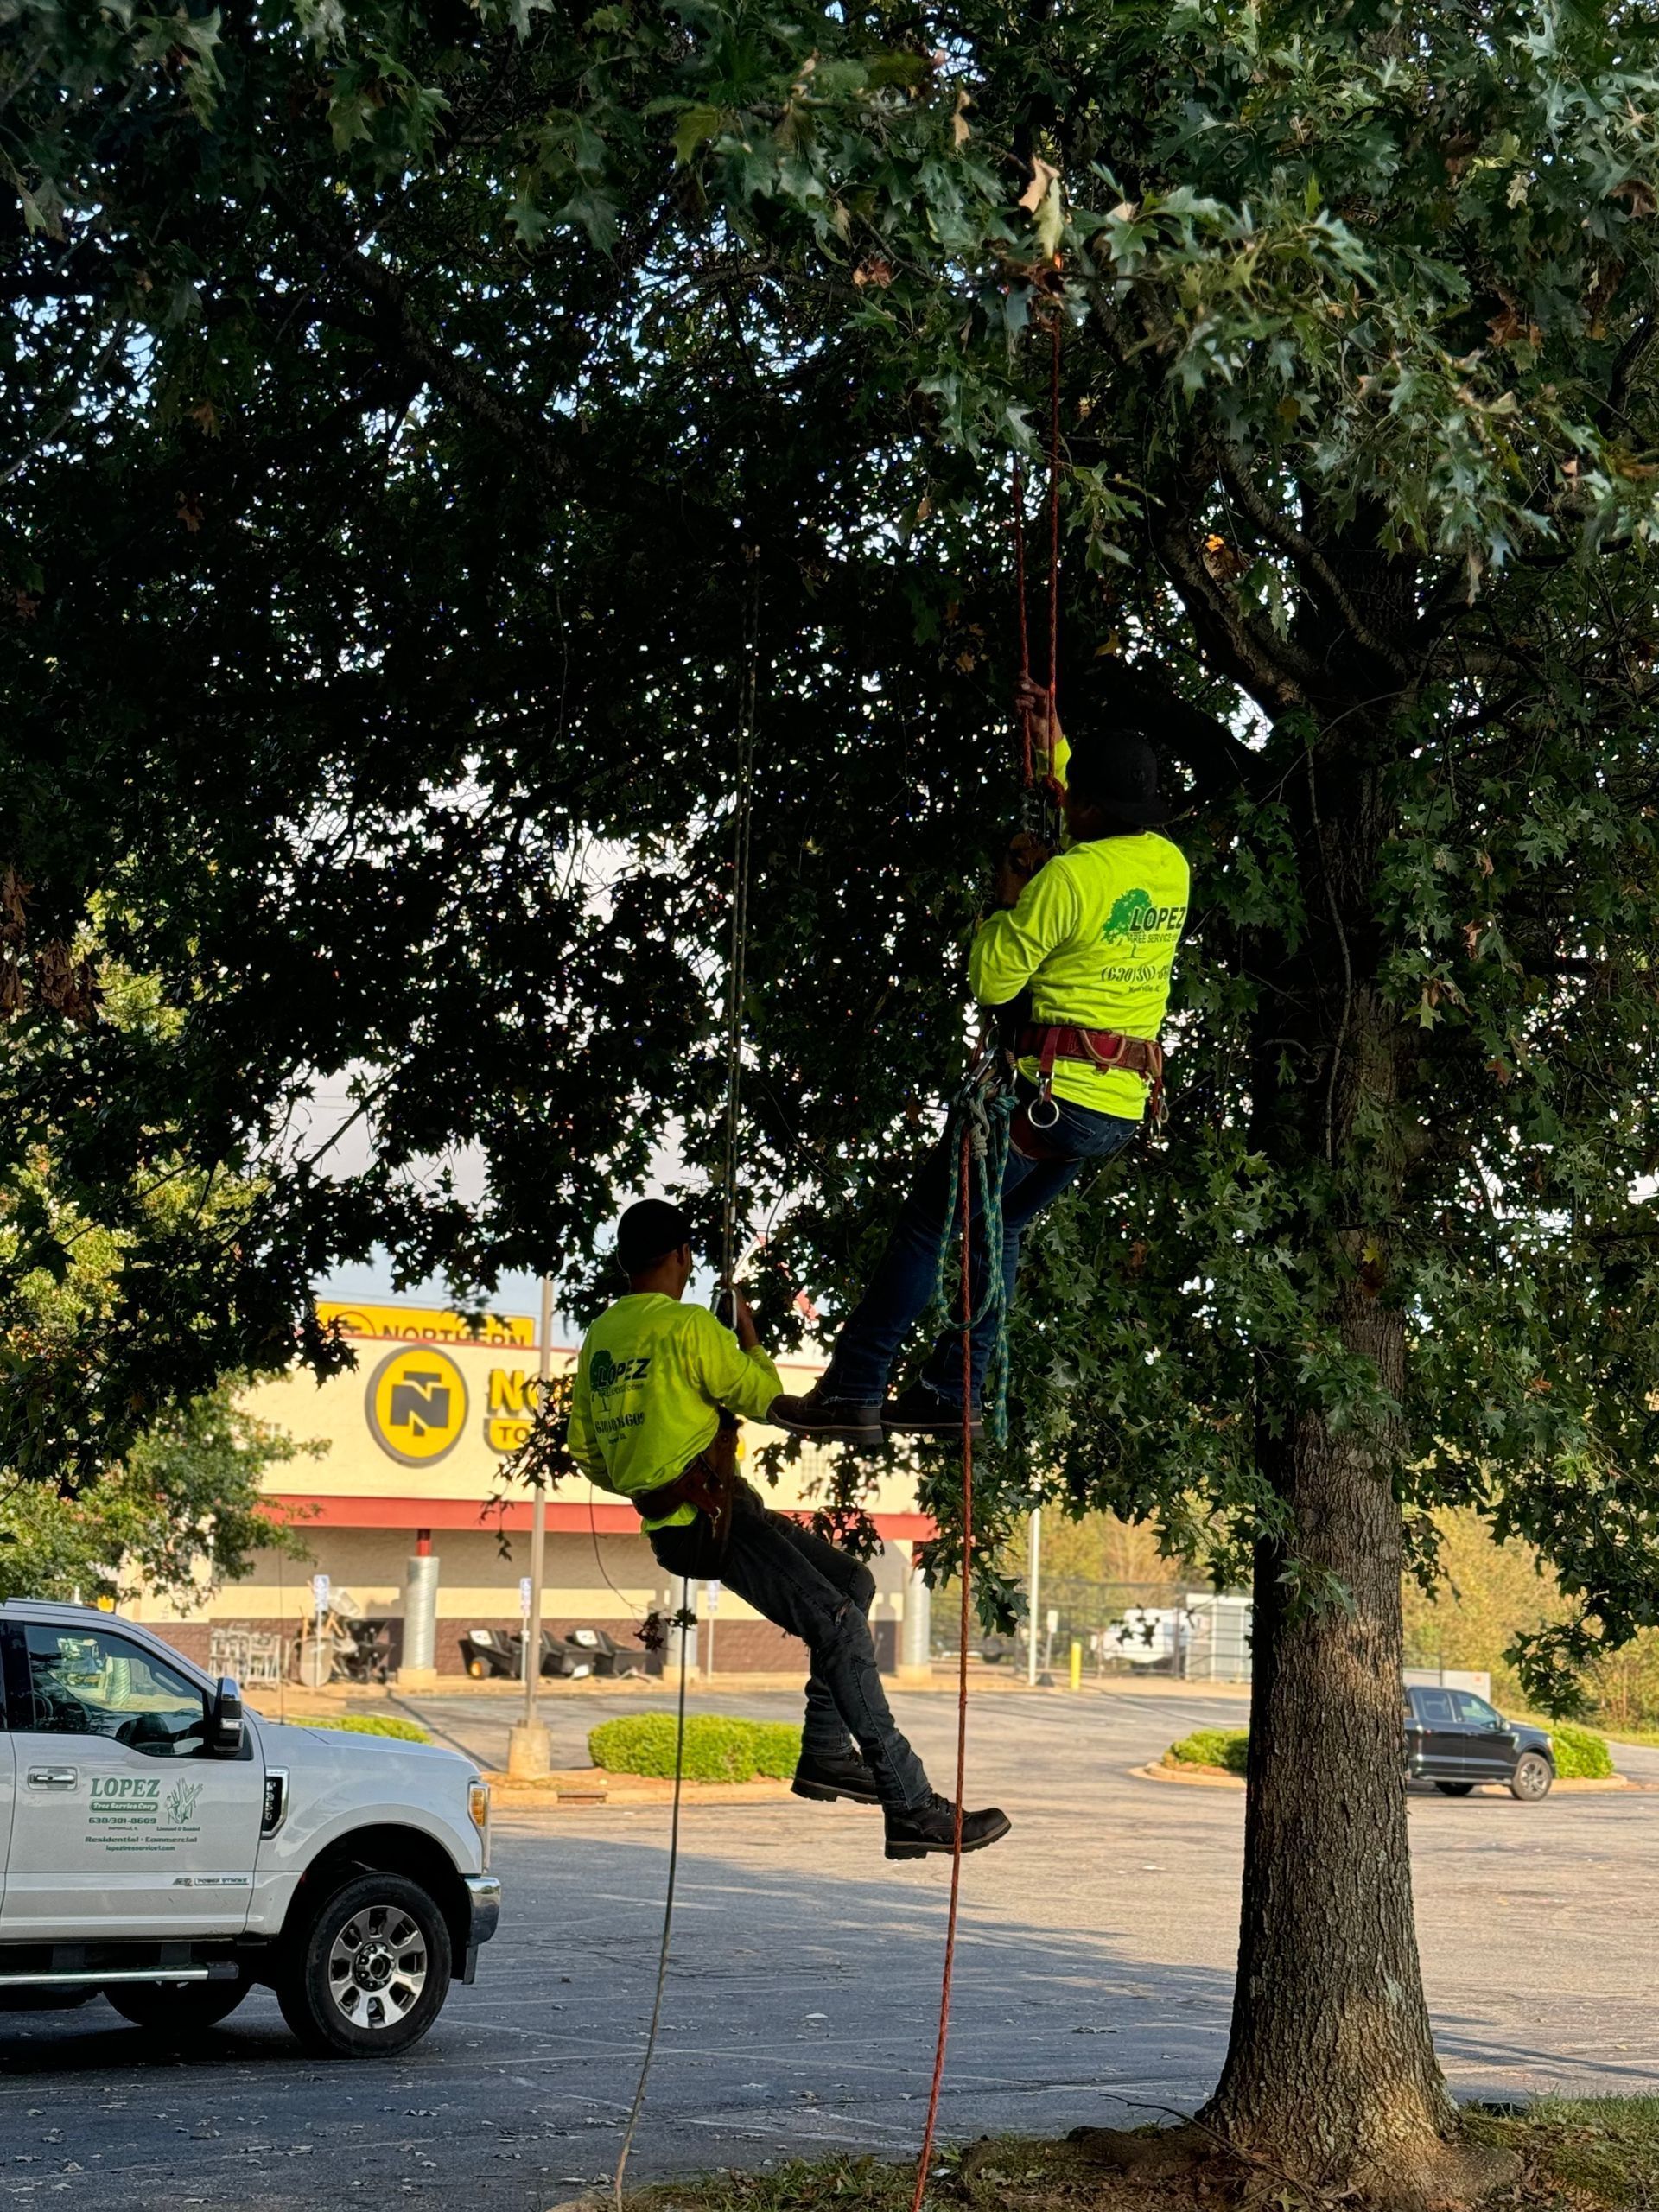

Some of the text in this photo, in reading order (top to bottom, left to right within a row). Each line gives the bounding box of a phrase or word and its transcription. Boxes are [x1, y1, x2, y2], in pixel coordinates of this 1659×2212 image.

[1129, 906, 1186, 931] LOPEZ
[598, 1358, 651, 1389] LOPEZ
[90, 1777, 161, 1797] LOPEZ
[92, 1802, 156, 1811] Tree Service Corp
